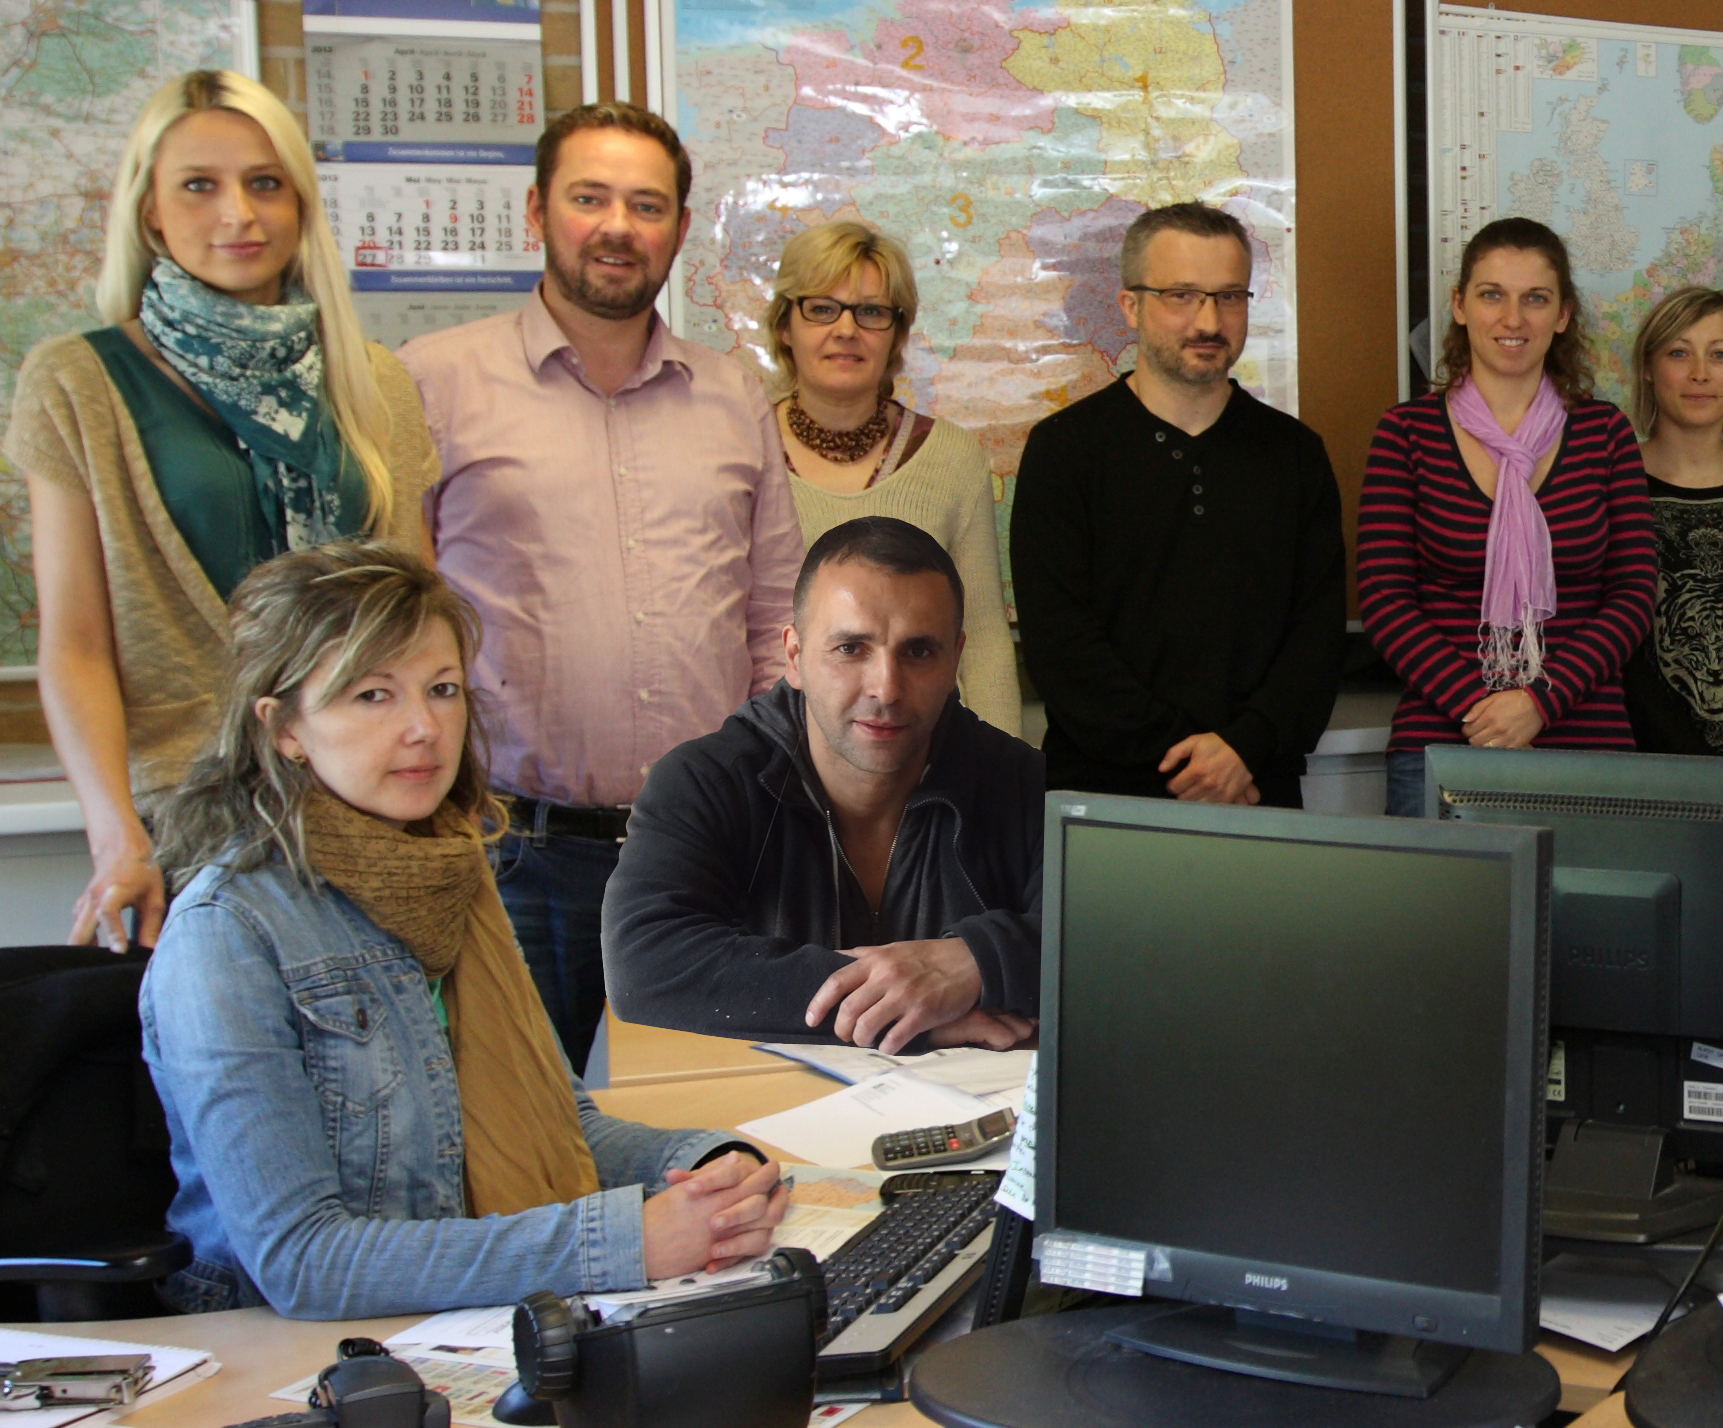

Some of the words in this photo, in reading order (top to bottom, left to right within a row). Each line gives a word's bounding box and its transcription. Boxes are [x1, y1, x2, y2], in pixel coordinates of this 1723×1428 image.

[900, 35, 924, 70] 2
[363, 70, 370, 80] 1
[388, 70, 396, 81] 2
[417, 70, 424, 81] 3
[443, 72, 451, 81] 4
[470, 72, 478, 83] 5
[525, 74, 532, 84] 7
[361, 84, 369, 95] 8
[388, 84, 397, 95] 9
[408, 84, 424, 95] 10
[436, 84, 450, 95] 11
[464, 85, 479, 97] 12
[491, 85, 506, 99] 13
[518, 88, 533, 97] 14
[354, 97, 370, 110] 15
[382, 97, 397, 108] 16
[409, 95, 425, 108] 17
[437, 98, 452, 108] 18
[465, 98, 480, 109] 19
[490, 99, 507, 111] 20
[517, 100, 533, 113] 21
[353, 110, 370, 122] 22
[381, 111, 398, 122] 23
[408, 111, 425, 122] 24
[436, 111, 453, 122] 25
[463, 111, 480, 122] 26
[491, 112, 507, 123] 27
[518, 113, 534, 124] 28
[354, 124, 371, 135] 29
[381, 124, 399, 136] 30
[424, 199, 430, 210] 1
[450, 199, 457, 210] 2
[477, 200, 484, 210] 3
[504, 200, 511, 210] 4
[950, 193, 973, 229] 3
[366, 212, 375, 223] 6
[396, 212, 402, 222] 7
[422, 213, 430, 223] 8
[450, 213, 458, 224] 9
[469, 213, 485, 224] 10
[497, 214, 511, 224] 11
[360, 226, 375, 237] 13
[388, 226, 403, 236] 14
[415, 226, 430, 237] 15
[443, 227, 458, 238] 16
[470, 227, 485, 237] 17
[497, 227, 512, 238] 18
[384, 240, 402, 252] 21
[414, 240, 431, 250] 22
[442, 240, 459, 251] 23
[469, 240, 486, 251] 24
[496, 241, 513, 251] 25
[523, 238, 541, 252] 26
[358, 253, 376, 264] 27
[1567, 949, 1650, 971] PHILIPS
[1245, 1273, 1288, 1291] PHILIPS
